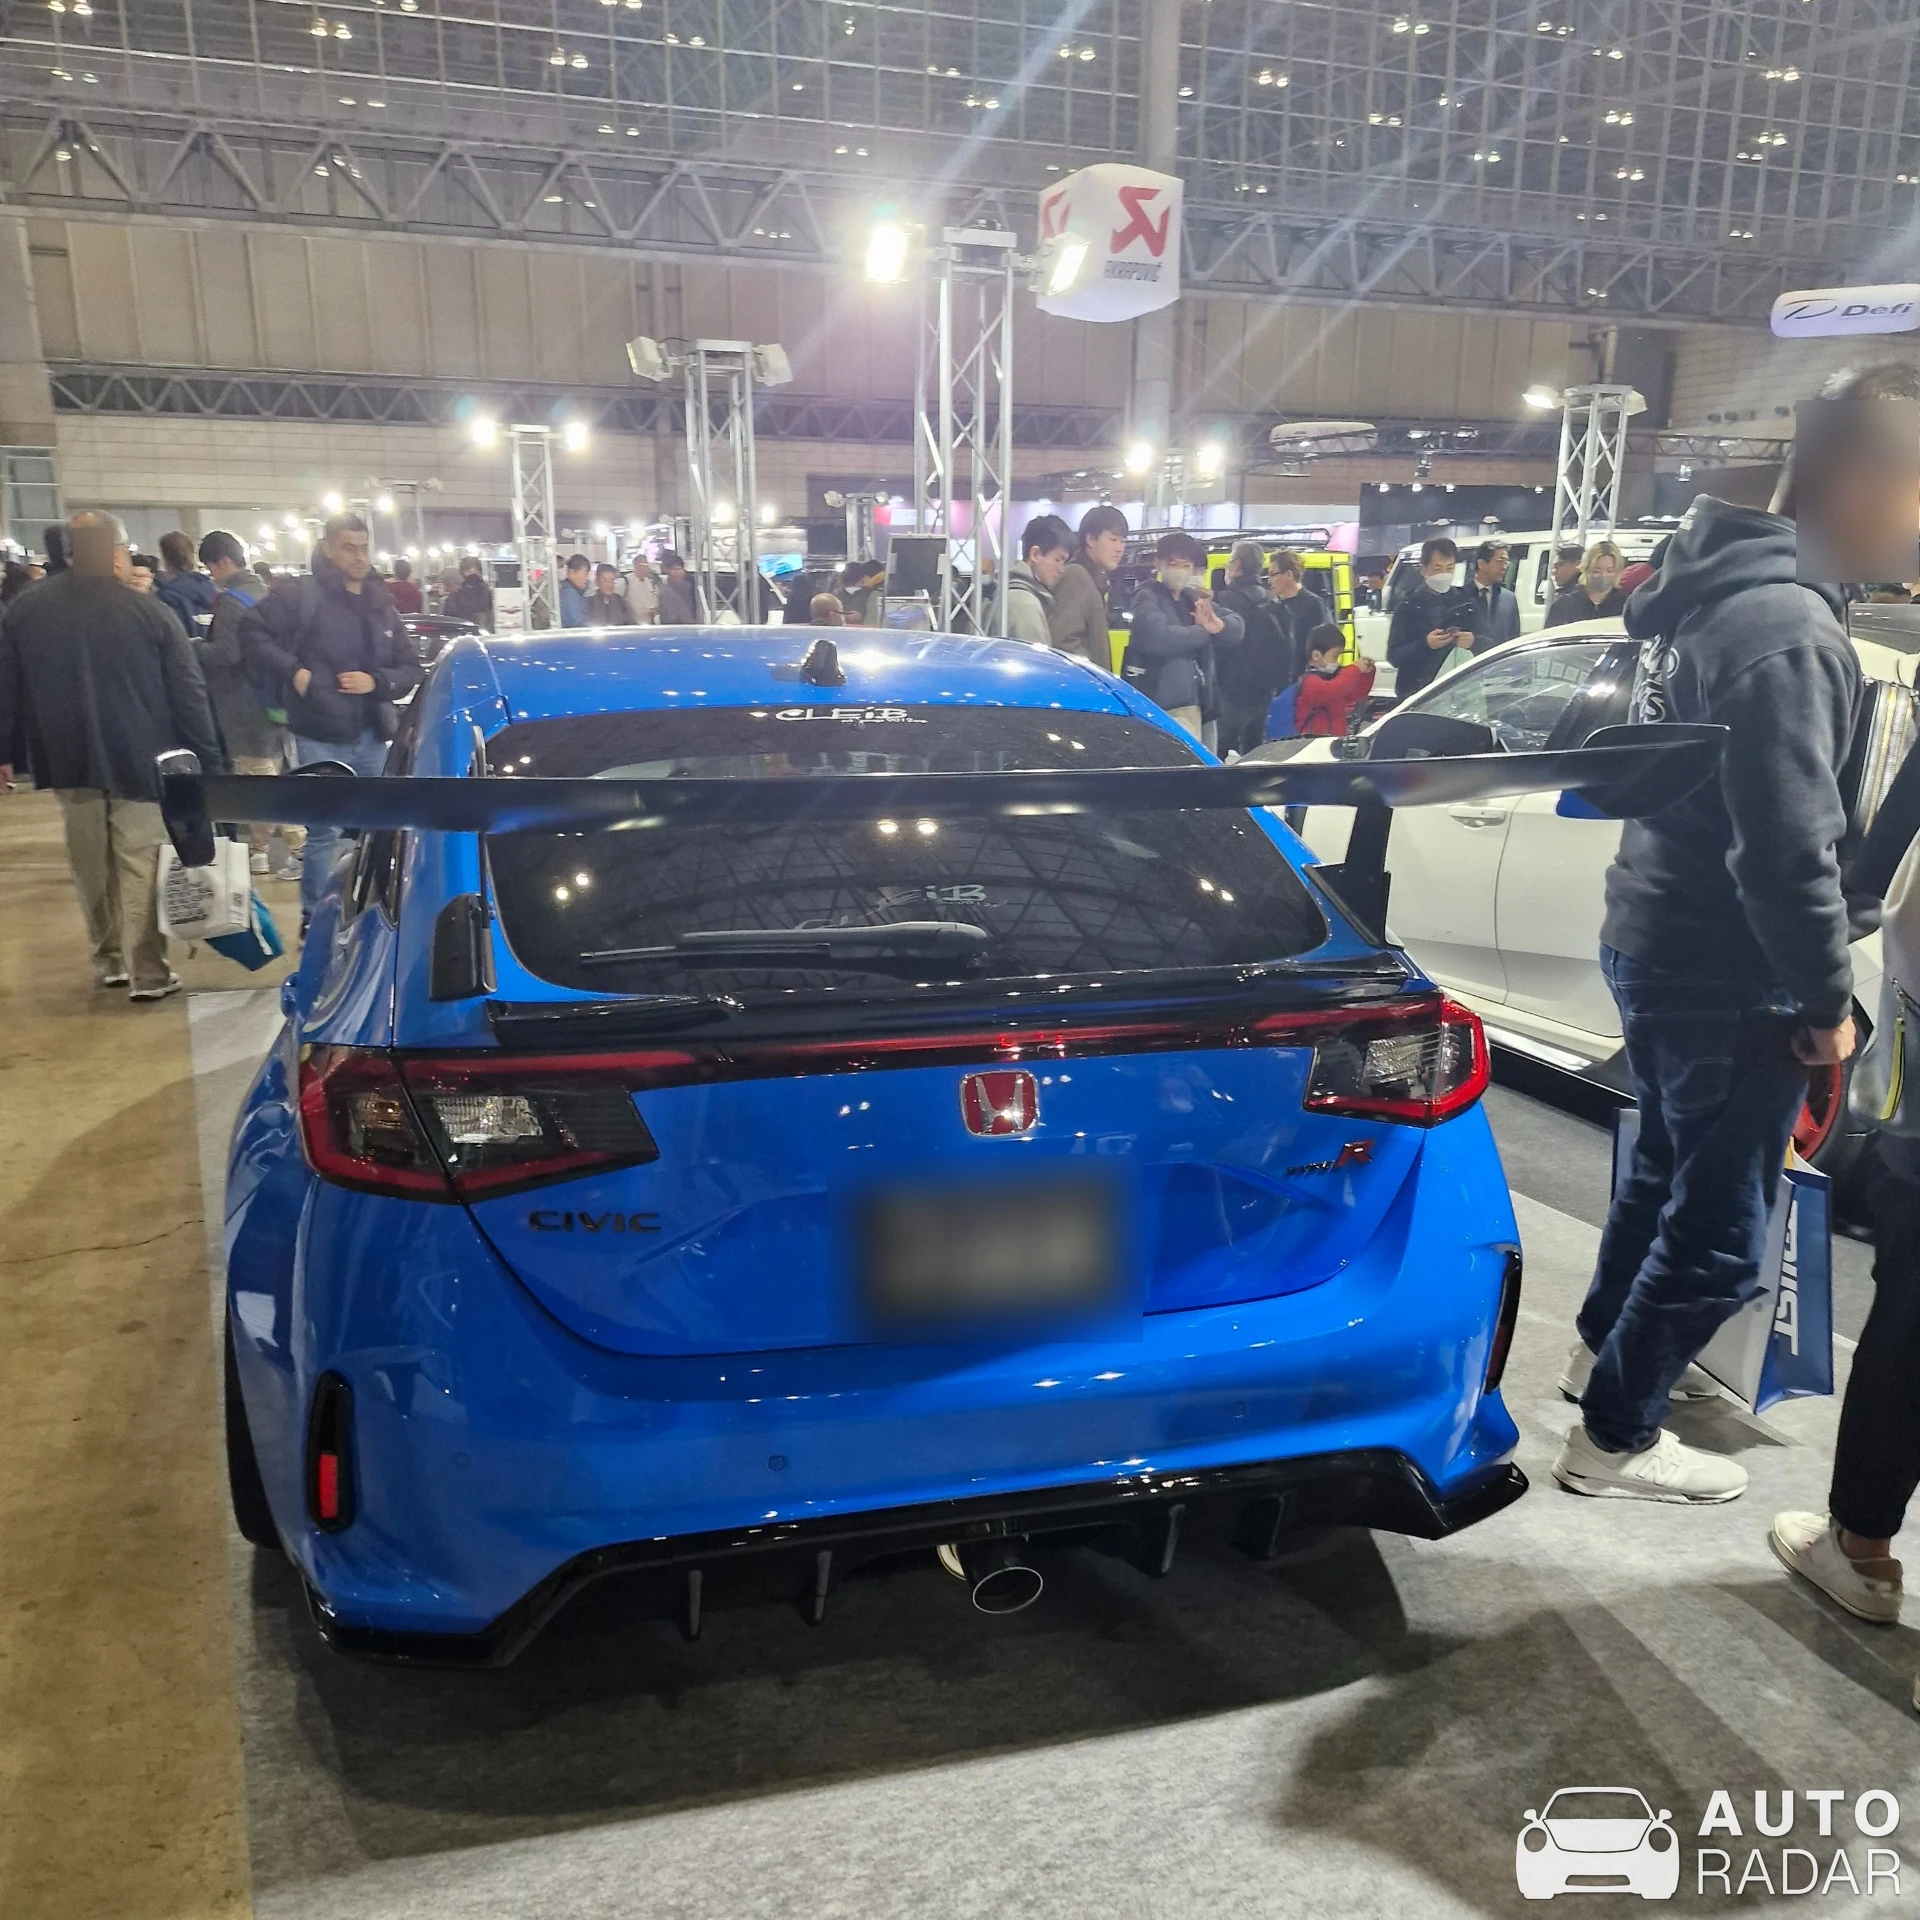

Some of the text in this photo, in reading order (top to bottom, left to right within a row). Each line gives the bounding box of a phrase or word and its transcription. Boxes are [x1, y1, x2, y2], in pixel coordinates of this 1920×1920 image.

[1841, 302, 1915, 317] Defi
[1335, 1138, 1375, 1168] R
[528, 1211, 662, 1232] CIVIC
